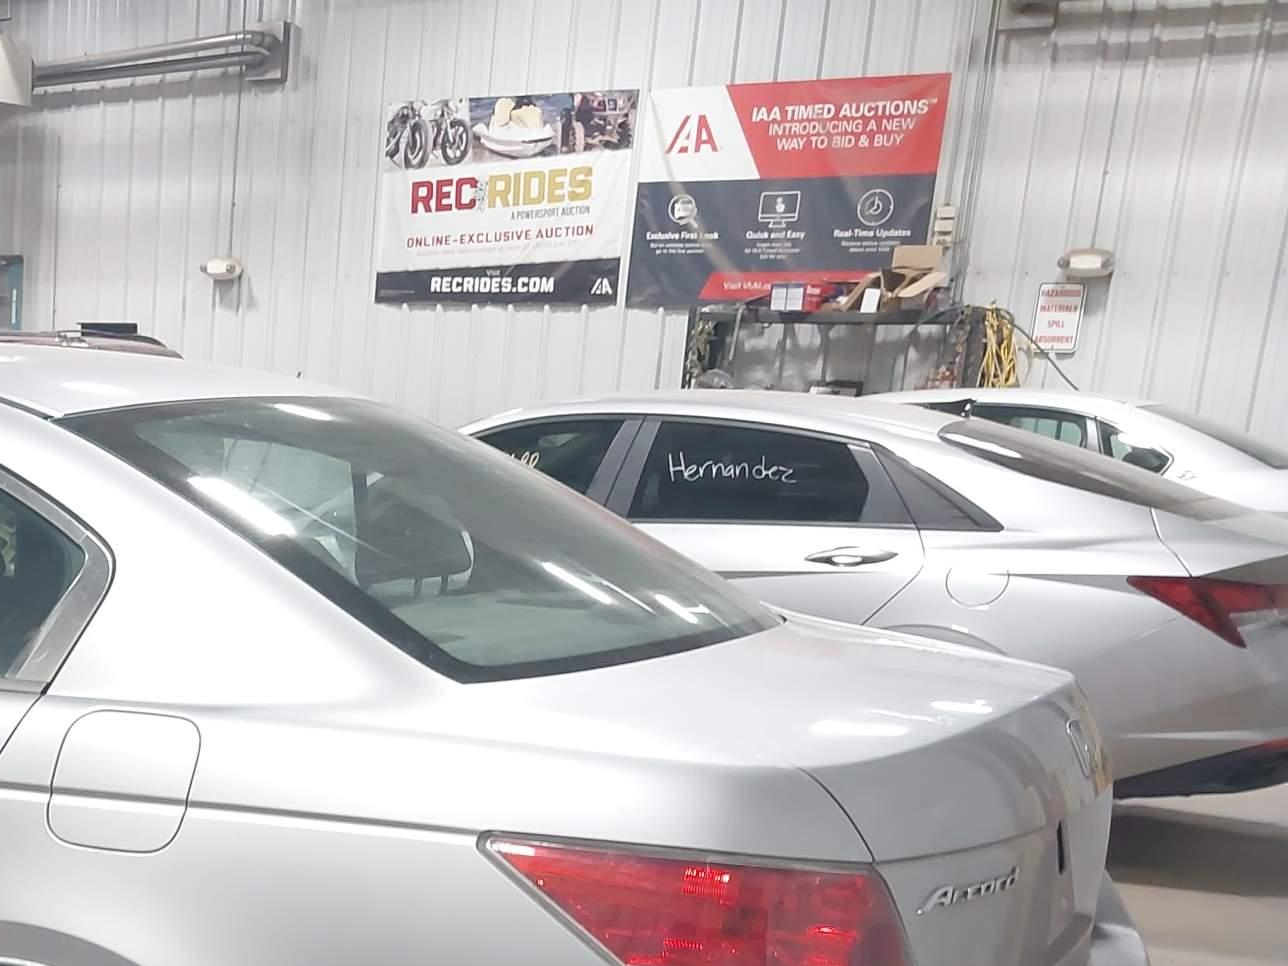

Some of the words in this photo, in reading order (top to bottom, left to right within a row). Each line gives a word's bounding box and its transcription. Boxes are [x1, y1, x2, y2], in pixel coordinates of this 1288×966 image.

[752, 106, 782, 122] IAA
[785, 103, 835, 121] TIMED
[768, 120, 862, 136] INTRODUCING
[867, 119, 878, 132] A
[880, 117, 916, 132] NEW
[776, 137, 806, 151] WAY
[810, 136, 828, 149] TO
[831, 135, 855, 149] BID
[858, 134, 869, 147] &
[873, 133, 904, 147] BUY
[410, 177, 479, 214] REC
[487, 166, 593, 209] RIDES
[561, 205, 591, 217] AUCTION
[407, 229, 531, 249] ONLINE-EXCLUSIVE
[535, 224, 594, 239] AUCTION
[646, 231, 679, 240] Exclusive
[745, 230, 769, 240] Quick
[770, 230, 785, 239] and
[786, 230, 806, 240] Easy
[833, 228, 874, 238] Real-Time
[876, 228, 912, 238] Updates
[430, 276, 555, 294] RECRIDES.COM
[723, 280, 742, 290] Visit
[668, 451, 797, 484] Hernandez
